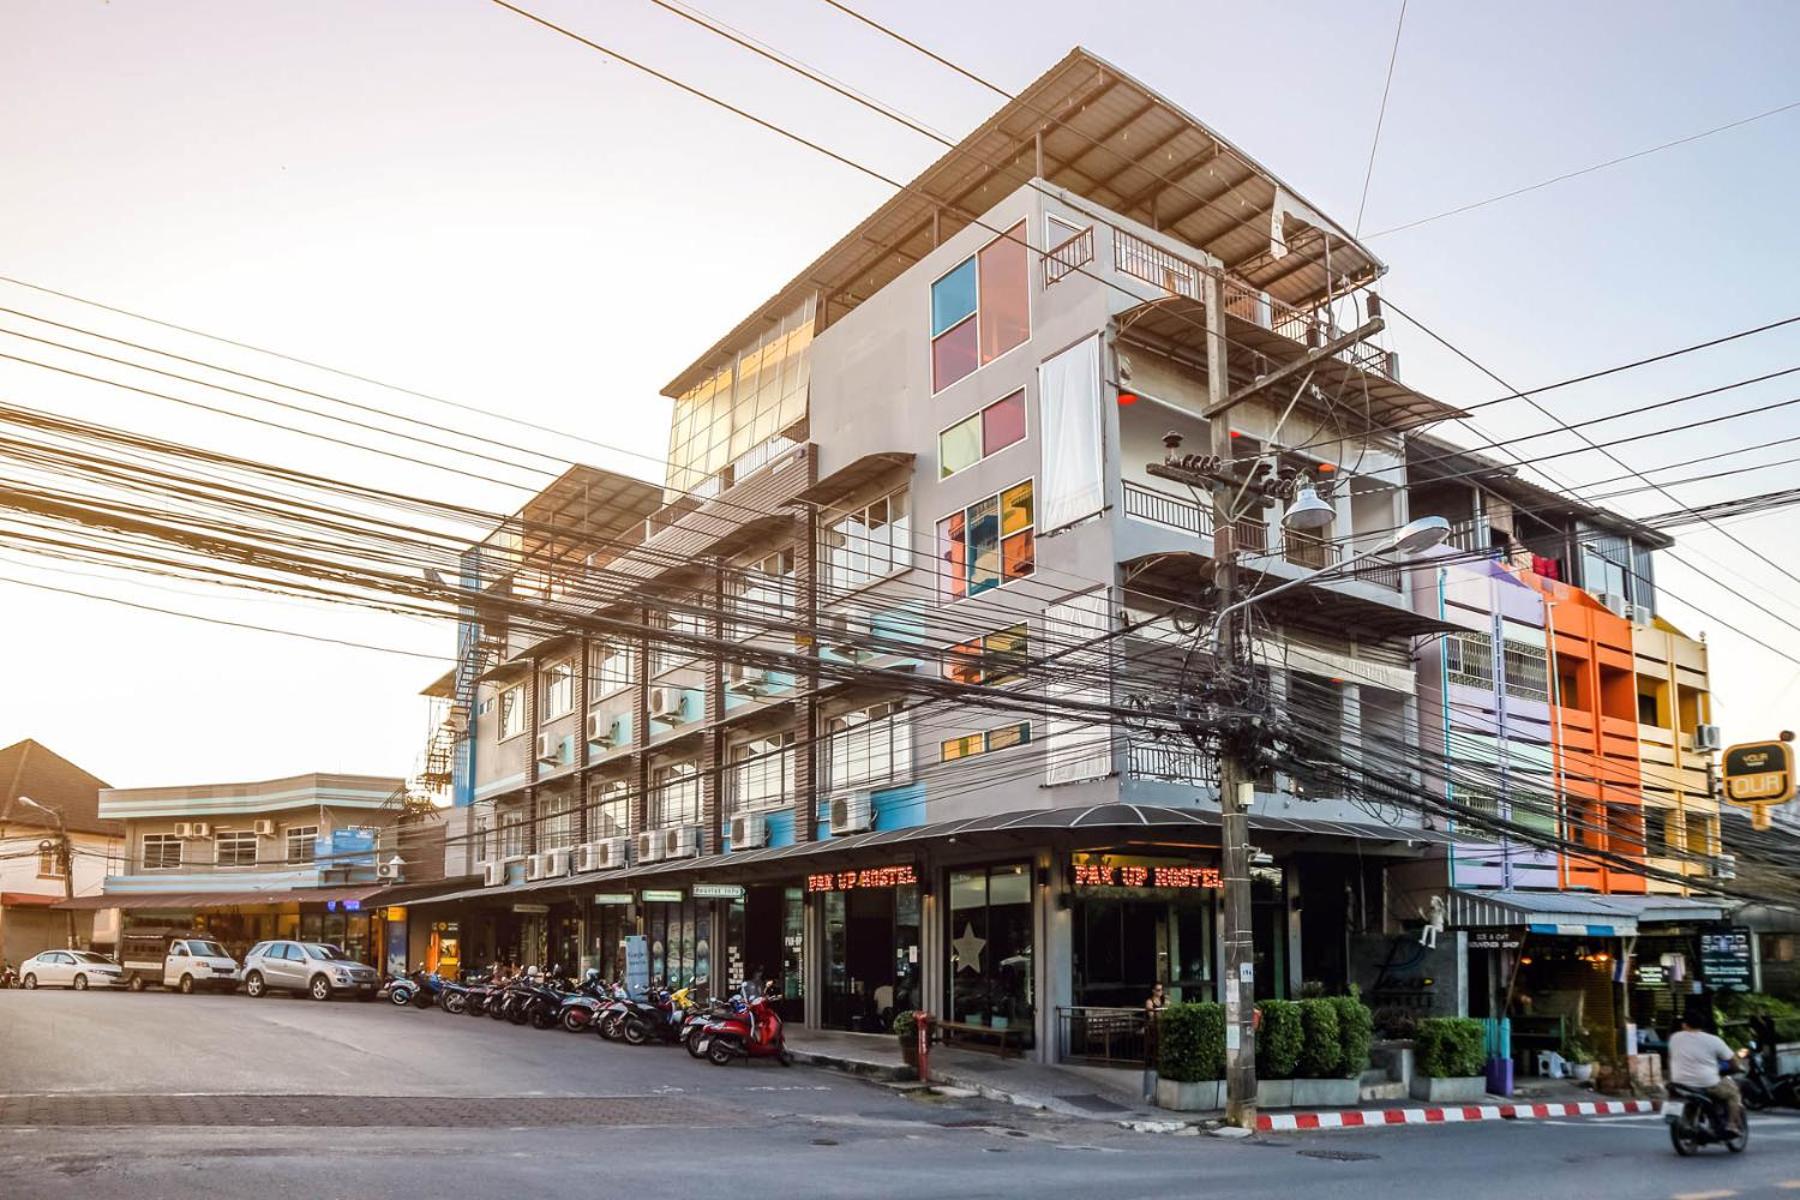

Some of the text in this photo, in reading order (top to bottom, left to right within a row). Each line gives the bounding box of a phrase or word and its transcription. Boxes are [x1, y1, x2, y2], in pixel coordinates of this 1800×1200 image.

[808, 865, 917, 892] PAK UP HOSTEL
[1075, 864, 1224, 888] PAK UP HOSTEL
